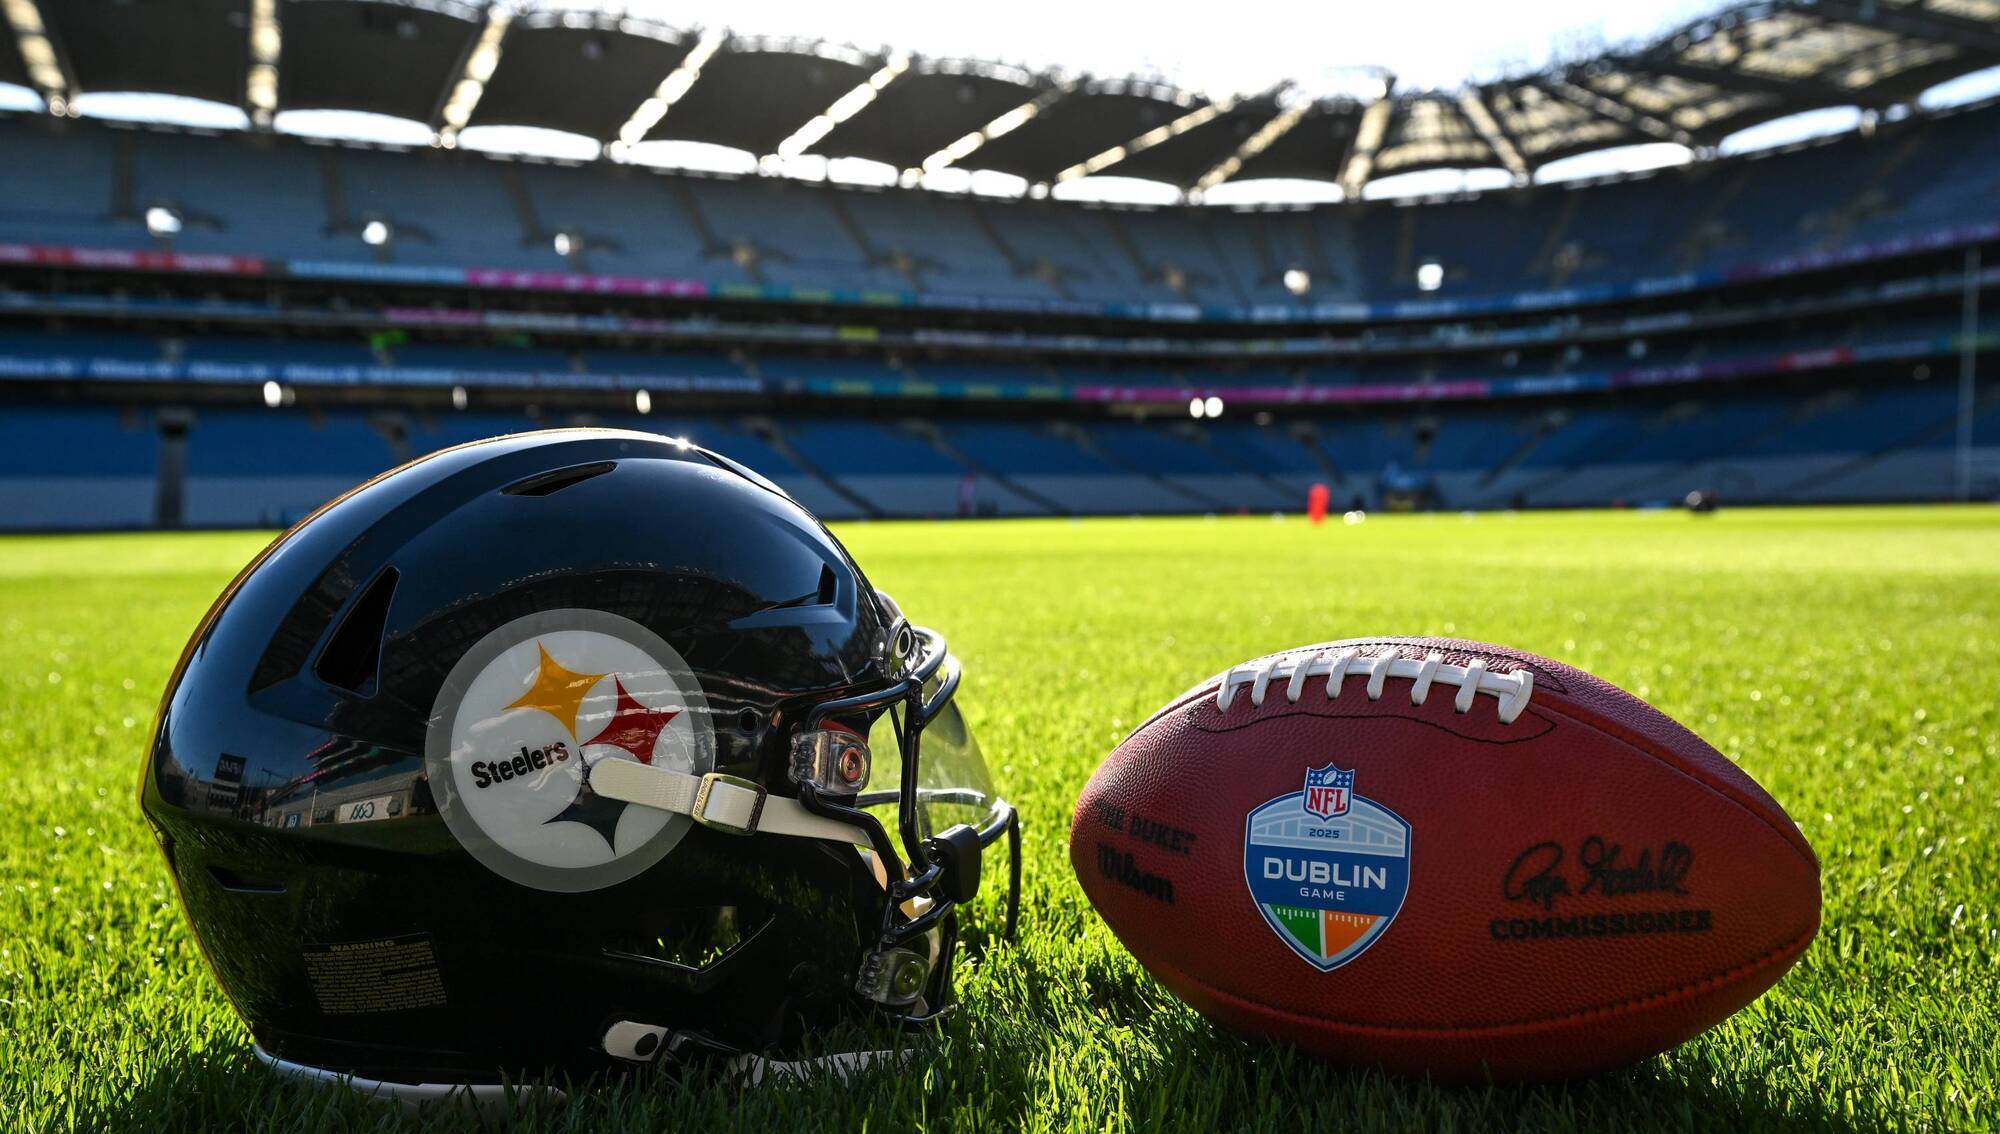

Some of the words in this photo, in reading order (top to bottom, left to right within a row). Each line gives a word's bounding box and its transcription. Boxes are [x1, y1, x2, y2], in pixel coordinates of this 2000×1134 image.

[471, 742, 569, 788] Steelers
[1308, 787, 1346, 814] NFL
[1309, 828, 1340, 839] 2025
[1263, 857, 1387, 890] DUBLIN
[1300, 887, 1345, 901] GAME
[1488, 910, 1713, 940] COMMISSIONER
[330, 940, 395, 952] WARNING
